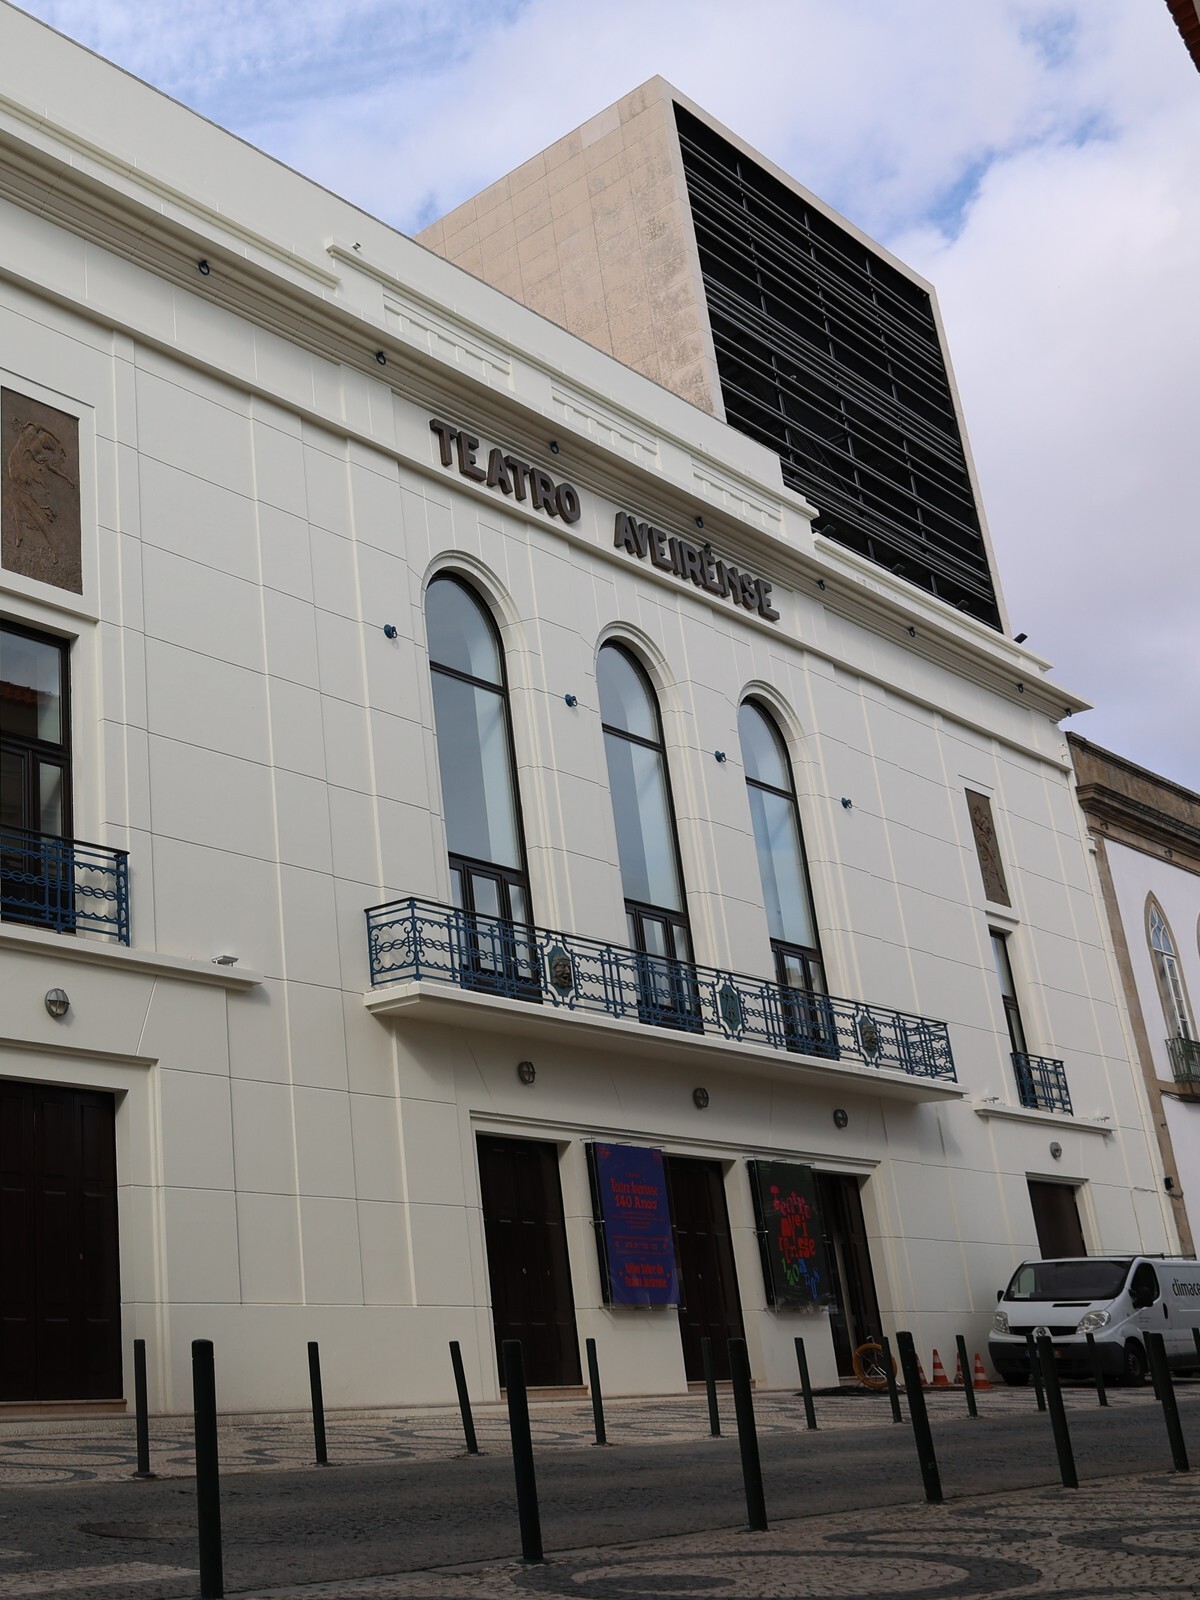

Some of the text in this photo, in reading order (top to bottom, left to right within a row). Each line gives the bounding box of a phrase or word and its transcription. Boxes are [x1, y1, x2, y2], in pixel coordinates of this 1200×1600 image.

[429, 418, 581, 524] TEATRO
[614, 1195, 657, 1209] 140 Anos
